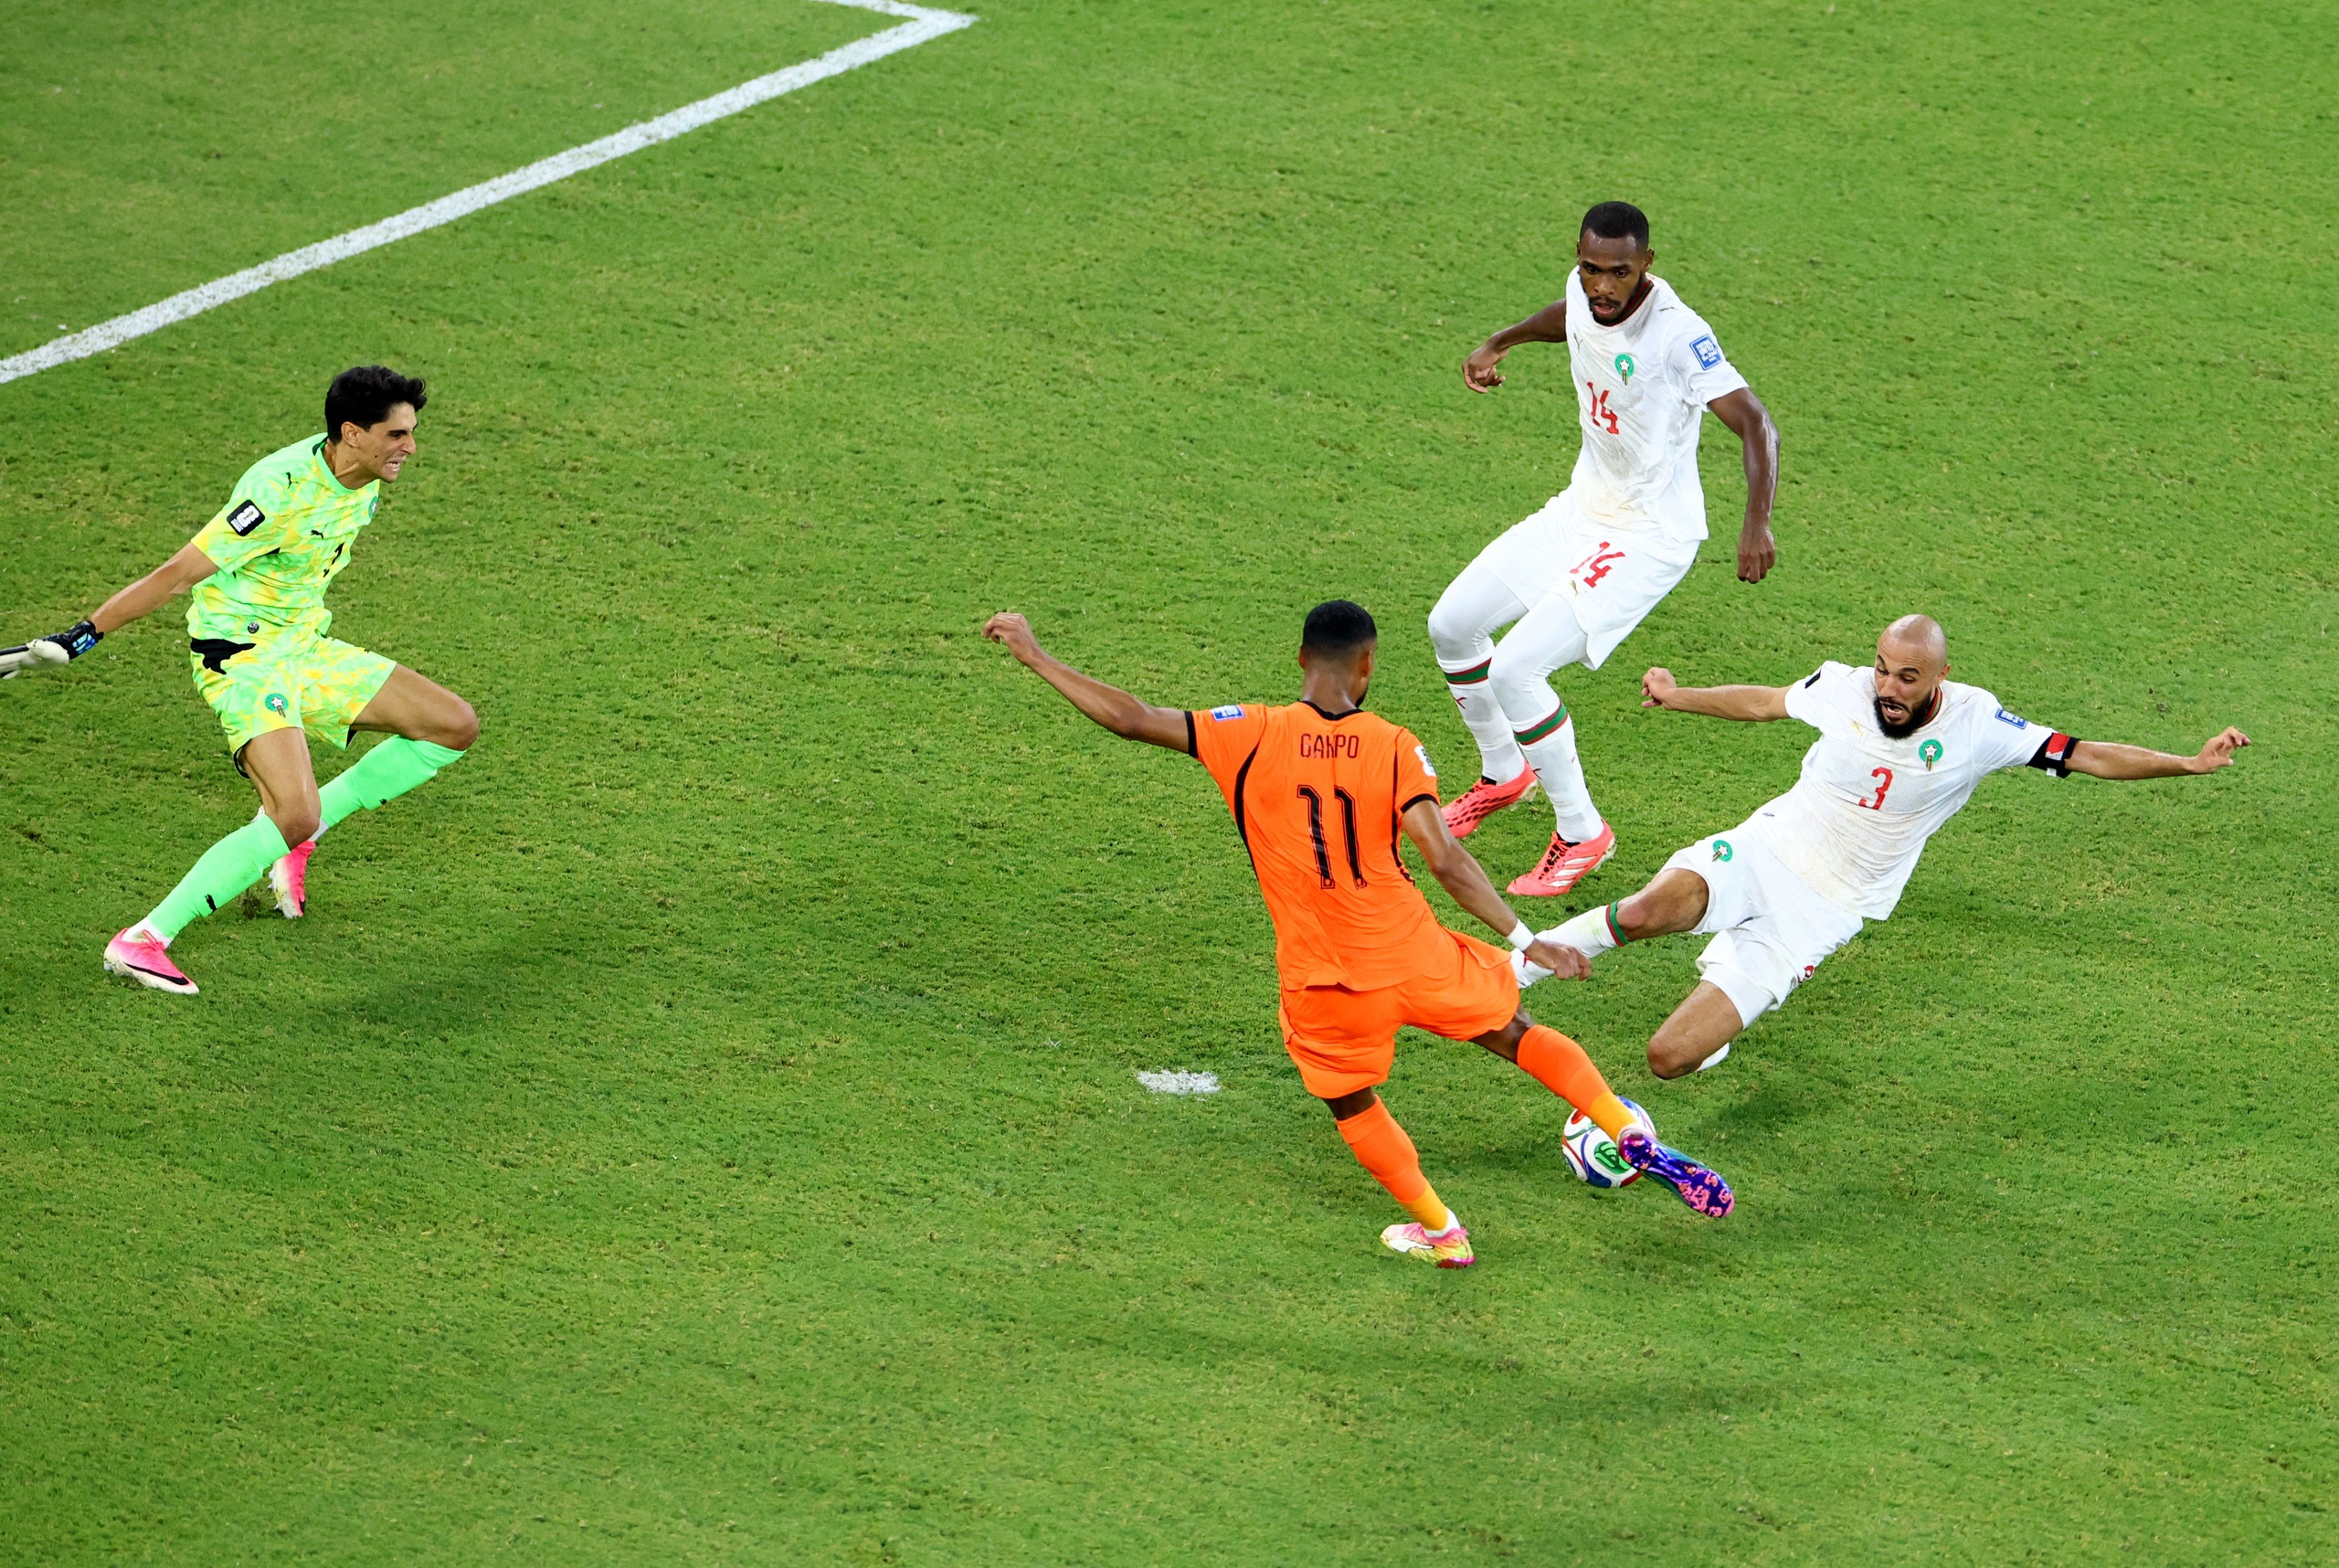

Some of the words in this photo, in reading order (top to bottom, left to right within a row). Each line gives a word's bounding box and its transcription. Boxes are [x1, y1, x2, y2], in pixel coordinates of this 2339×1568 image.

[1587, 382, 1619, 434] 14
[1570, 542, 1625, 588] 14
[1300, 734, 1358, 758] GAKPO
[1858, 767, 1892, 810] 3
[1297, 785, 1367, 889] 11
